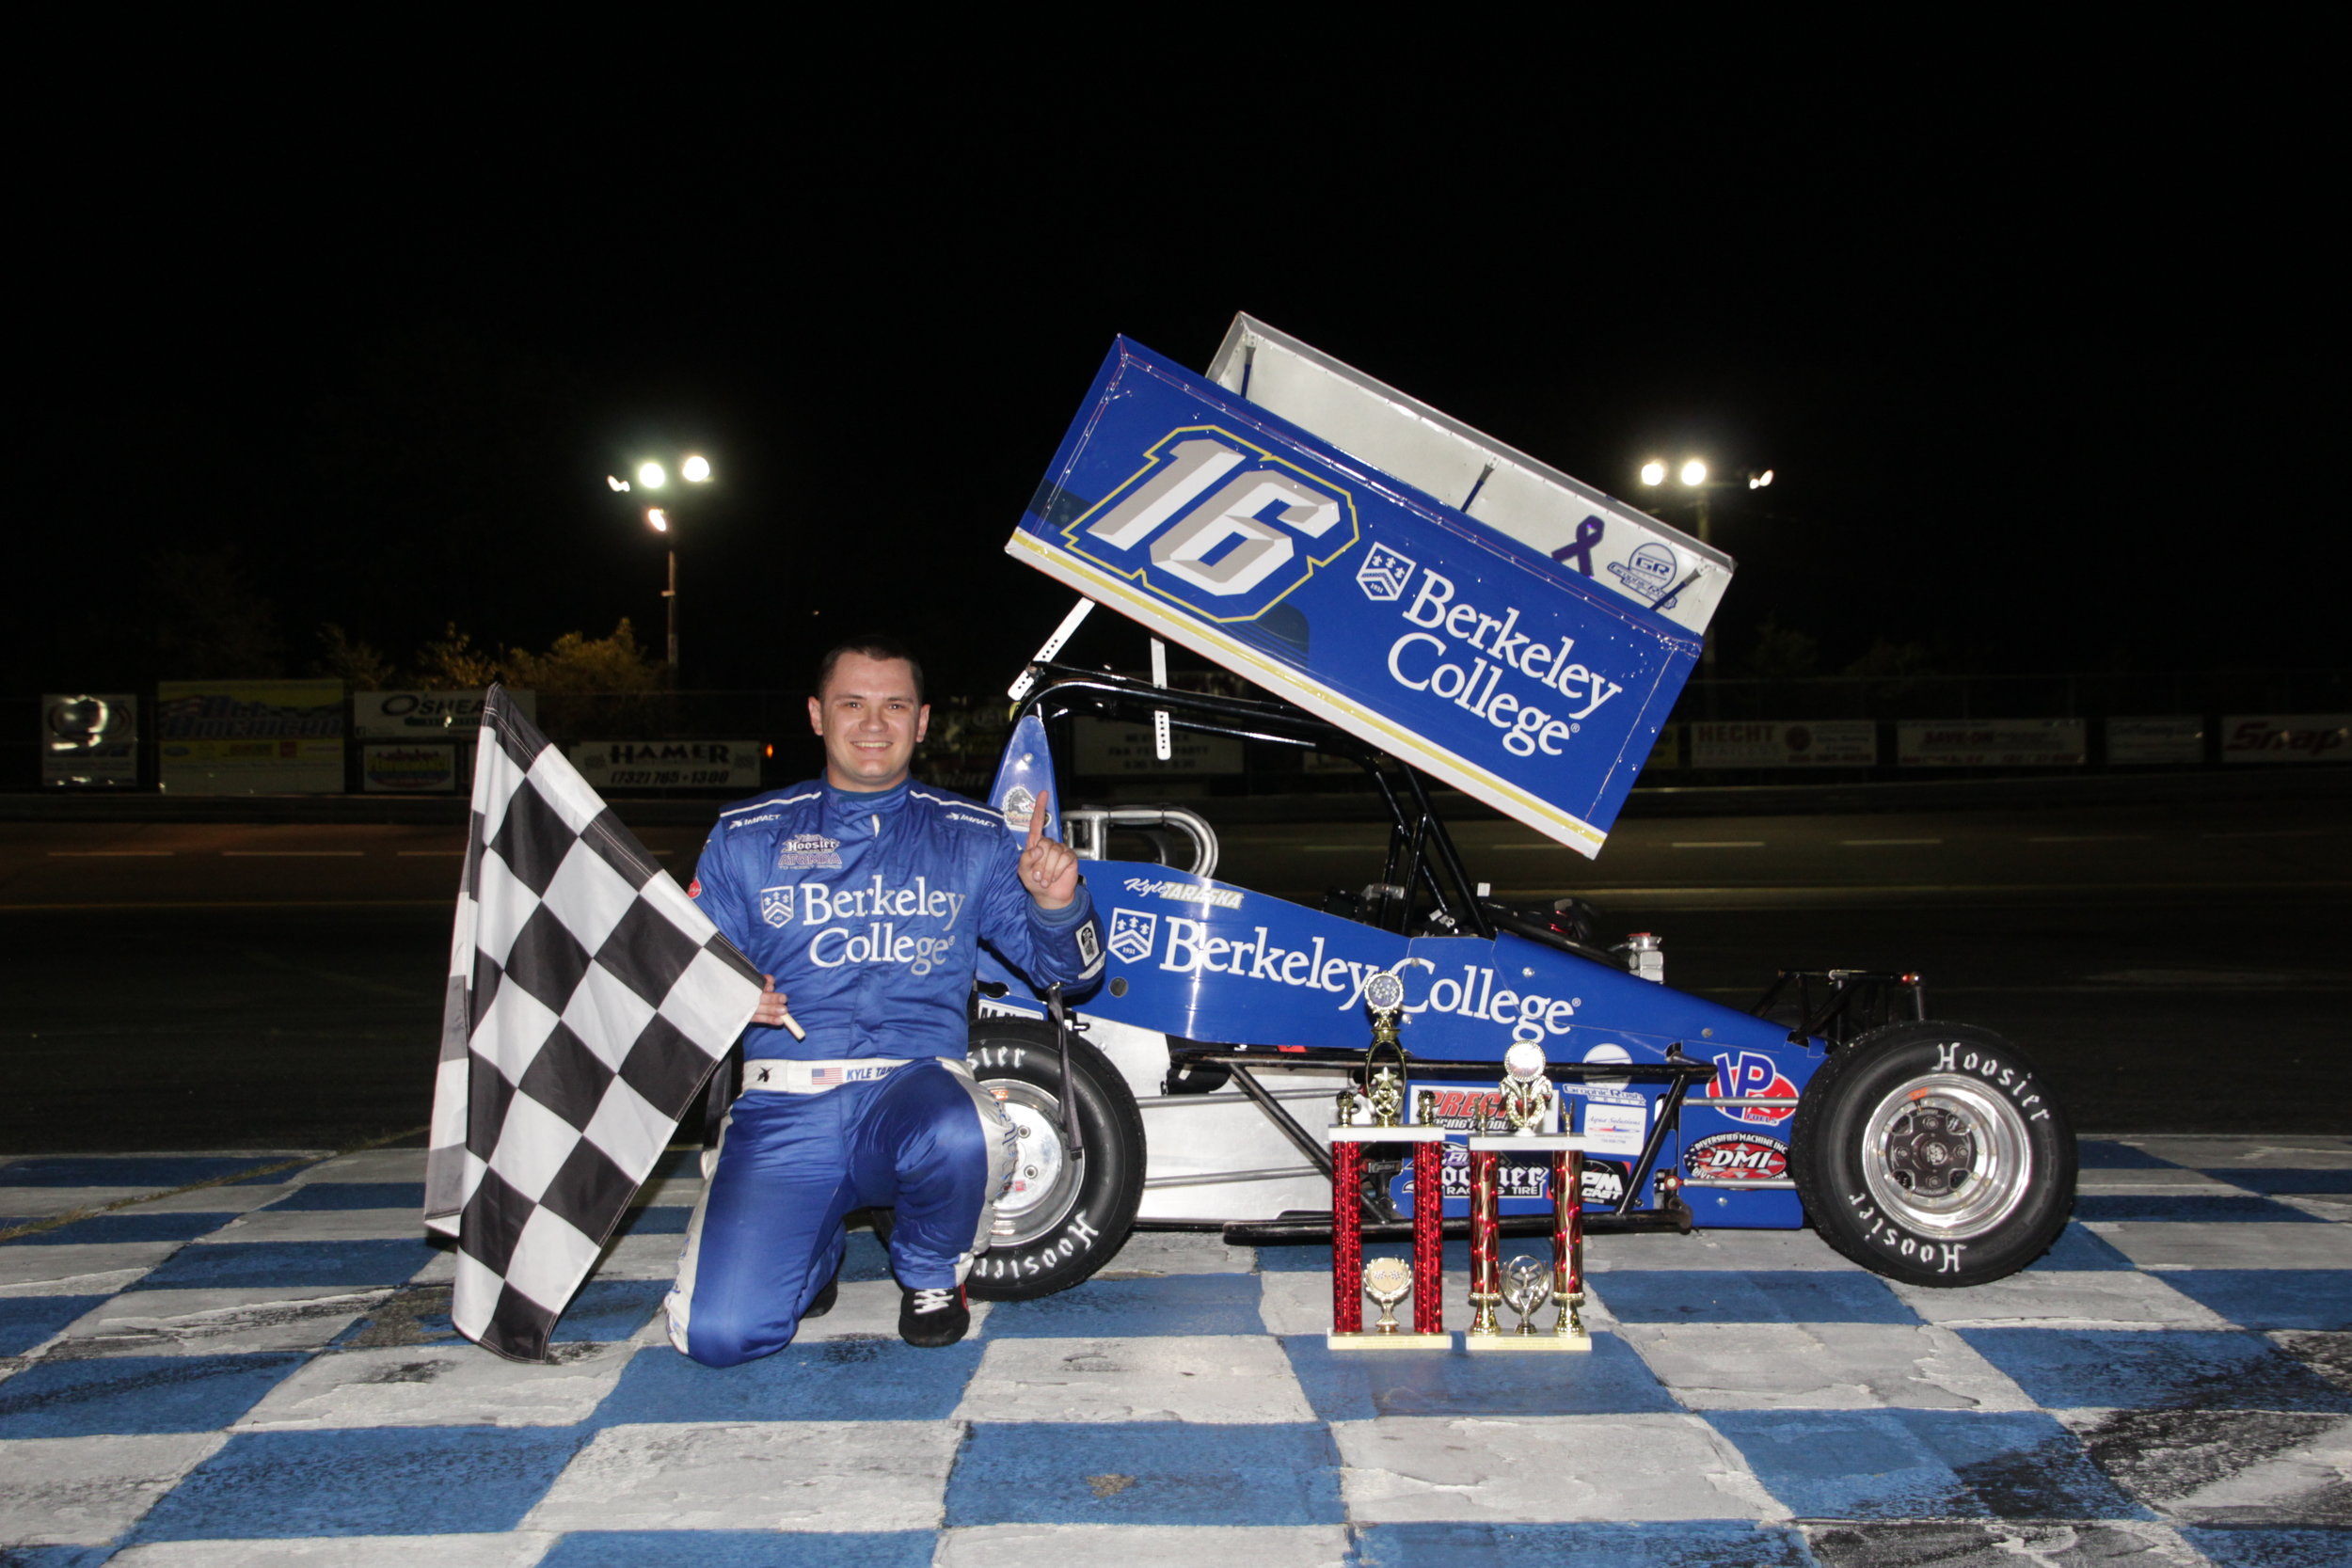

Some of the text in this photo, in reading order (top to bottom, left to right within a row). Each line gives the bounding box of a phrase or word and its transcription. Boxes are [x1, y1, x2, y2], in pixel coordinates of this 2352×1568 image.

[1086, 438, 1340, 596] 16
[1635, 556, 1670, 576] GR
[1402, 568, 1622, 720] Berkeley
[1698, 725, 1774, 743] HECHT
[612, 745, 728, 764] HAMER
[744, 815, 781, 825] IMPACT
[960, 815, 997, 828] IMPACT
[787, 840, 835, 851] Hoosier
[801, 875, 963, 930] Berkeley
[1123, 879, 1243, 909] Kyle TARASKA
[1159, 915, 1380, 1011] Berkeley
[844, 1068, 872, 1081] KYLE
[1931, 1042, 2049, 1121] Hoosier
[1712, 1051, 1776, 1121] VP
[1746, 1113, 1777, 1124] FUELS
[1694, 1132, 1788, 1155] DIVERSIFIED MACHINE INC
[1710, 1149, 1772, 1169] DMI
[1511, 1186, 1538, 1196] TIRE
[1581, 1187, 1623, 1200] CAST
[1849, 1193, 1967, 1274] Hoosier
[974, 1210, 1099, 1279] Hoosier
